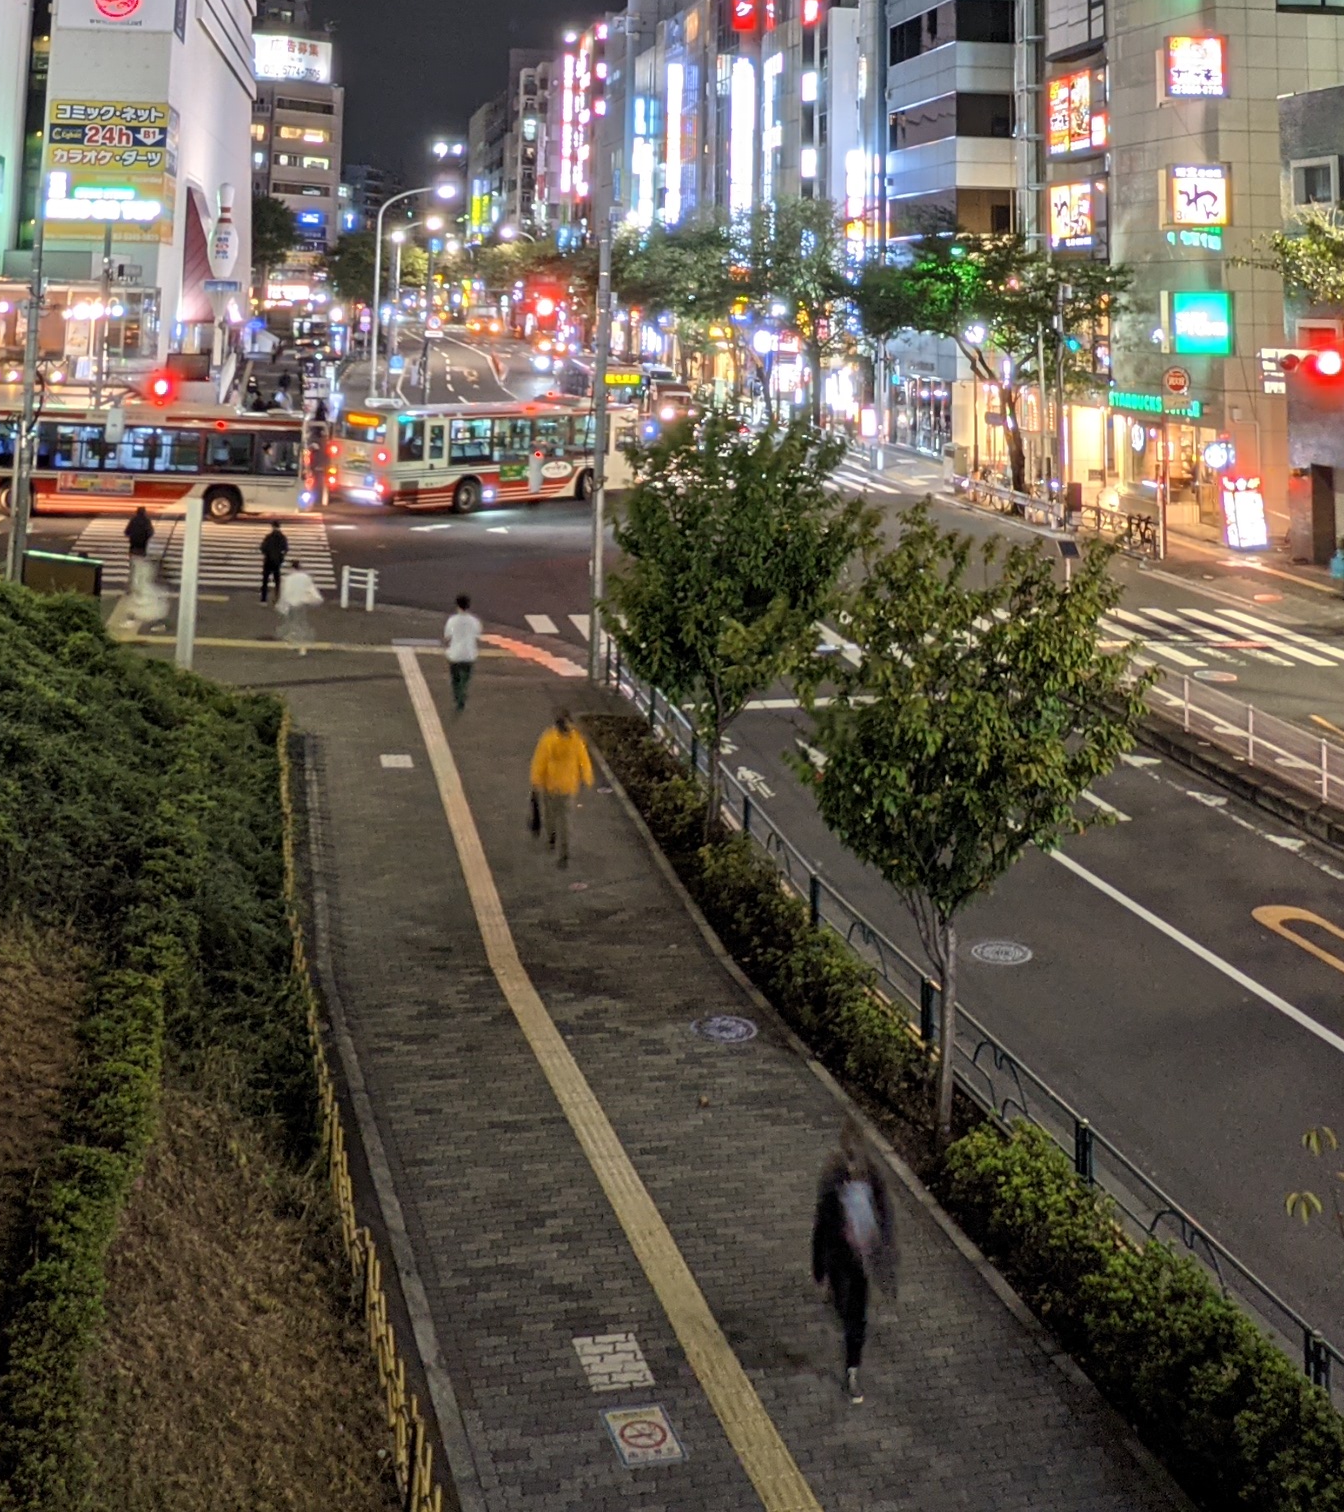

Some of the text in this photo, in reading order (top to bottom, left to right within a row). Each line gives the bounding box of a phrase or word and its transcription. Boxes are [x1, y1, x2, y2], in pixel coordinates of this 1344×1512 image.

[56, 104, 164, 122] コミック・ネット
[84, 124, 133, 147] 24h
[143, 129, 157, 140] B1
[52, 149, 162, 167] カラオケ・ダーツ
[1108, 390, 1163, 414] STARBUCKS
